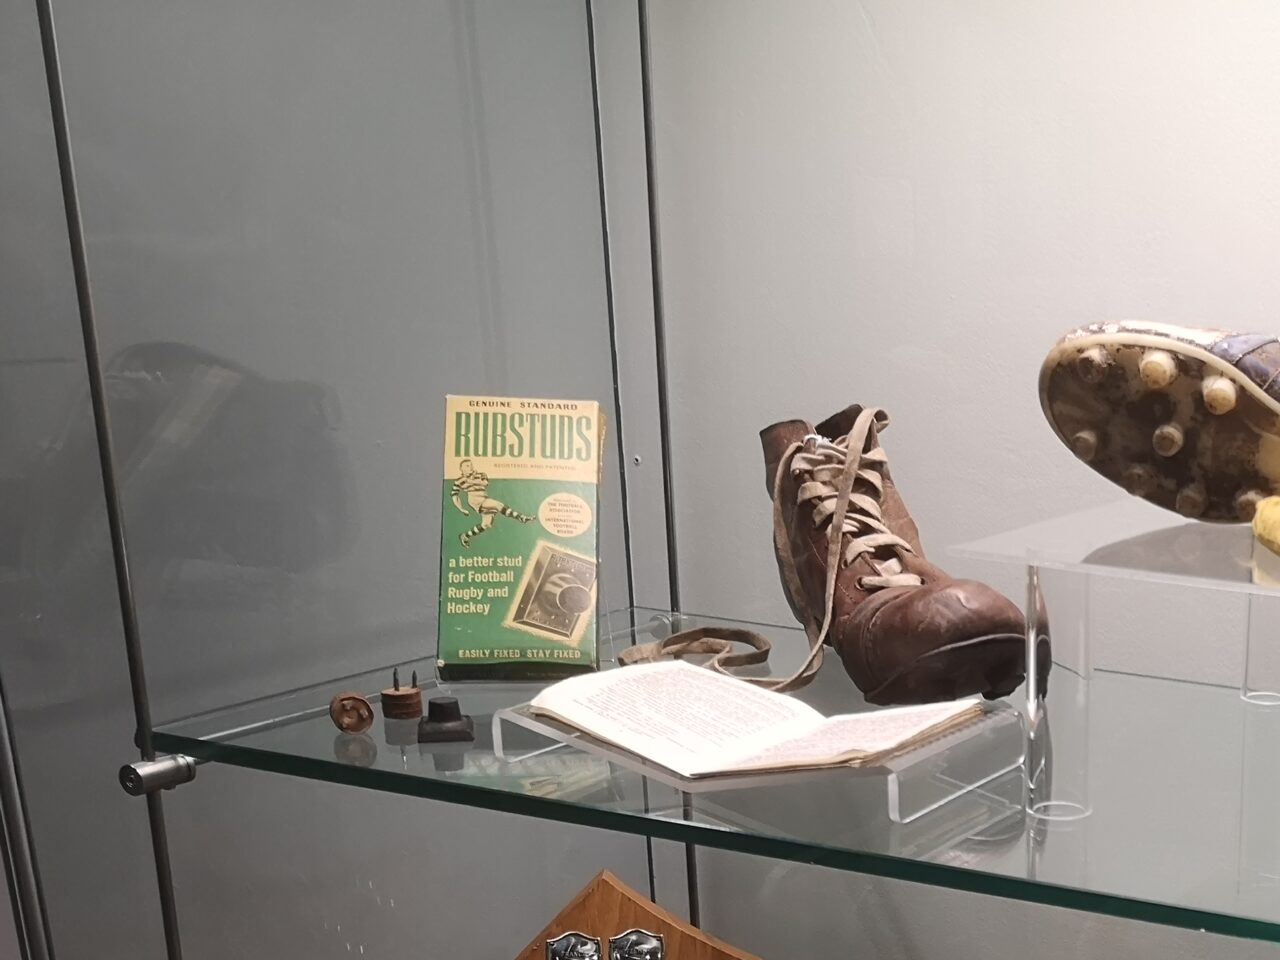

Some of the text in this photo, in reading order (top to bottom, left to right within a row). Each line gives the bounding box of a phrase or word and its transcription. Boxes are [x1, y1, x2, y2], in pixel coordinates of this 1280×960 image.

[469, 400, 578, 411] GENUINE STANDARD
[454, 411, 592, 462] RUBSTUDS
[449, 556, 522, 567] a better stud
[448, 571, 514, 583] for Football
[448, 586, 509, 600] Rugby and
[447, 602, 491, 615] Hockey
[459, 649, 581, 659] EASILY FIXED STAY FIXED
